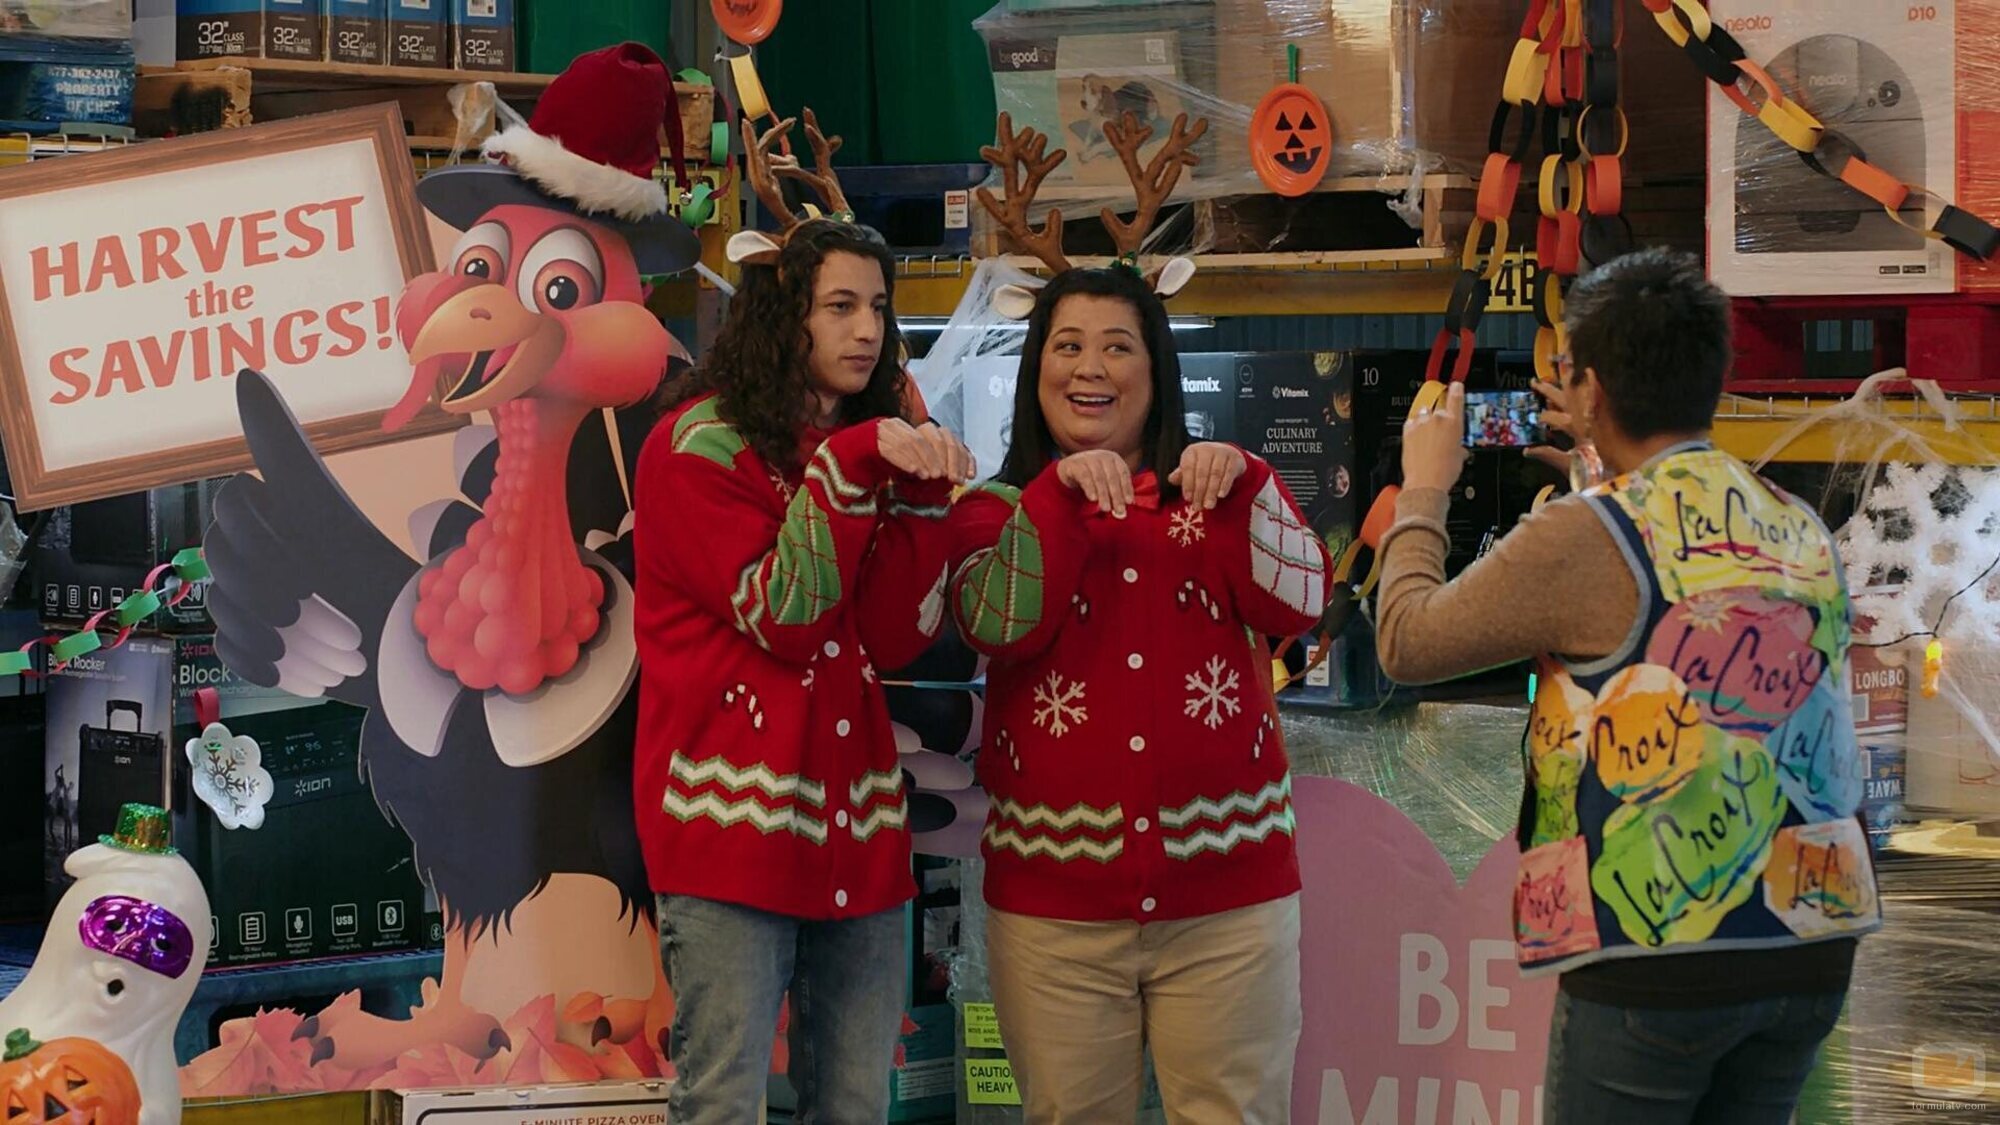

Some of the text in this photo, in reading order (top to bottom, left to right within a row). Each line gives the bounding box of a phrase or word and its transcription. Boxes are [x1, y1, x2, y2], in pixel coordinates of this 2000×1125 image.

[1908, 6, 1936, 21] D10
[1725, 15, 1772, 31] neato
[55, 81, 120, 96] PROPERTY
[29, 195, 364, 301] HARVEST
[184, 280, 254, 318] the
[49, 296, 393, 404] SAVINGS!
[1362, 368, 1379, 386] 10
[1266, 428, 1317, 439] CULINARY
[1262, 442, 1322, 454] ADVENTURE
[1726, 487, 1807, 561] Croix
[74, 655, 106, 671] Rocker
[1711, 625, 1821, 716] Croix
[180, 664, 231, 685] Block
[1855, 669, 1905, 689] LONGBO
[1868, 779, 1900, 799] WAVE
[1652, 751, 1760, 902] Croix
[336, 915, 353, 926] USB
[1398, 933, 1516, 1052] BE
[970, 1066, 1013, 1078] CAUTIO
[977, 1082, 1013, 1093] HEAVY
[588, 1116, 624, 1125] PIZZA
[629, 1114, 665, 1125] OVEN
